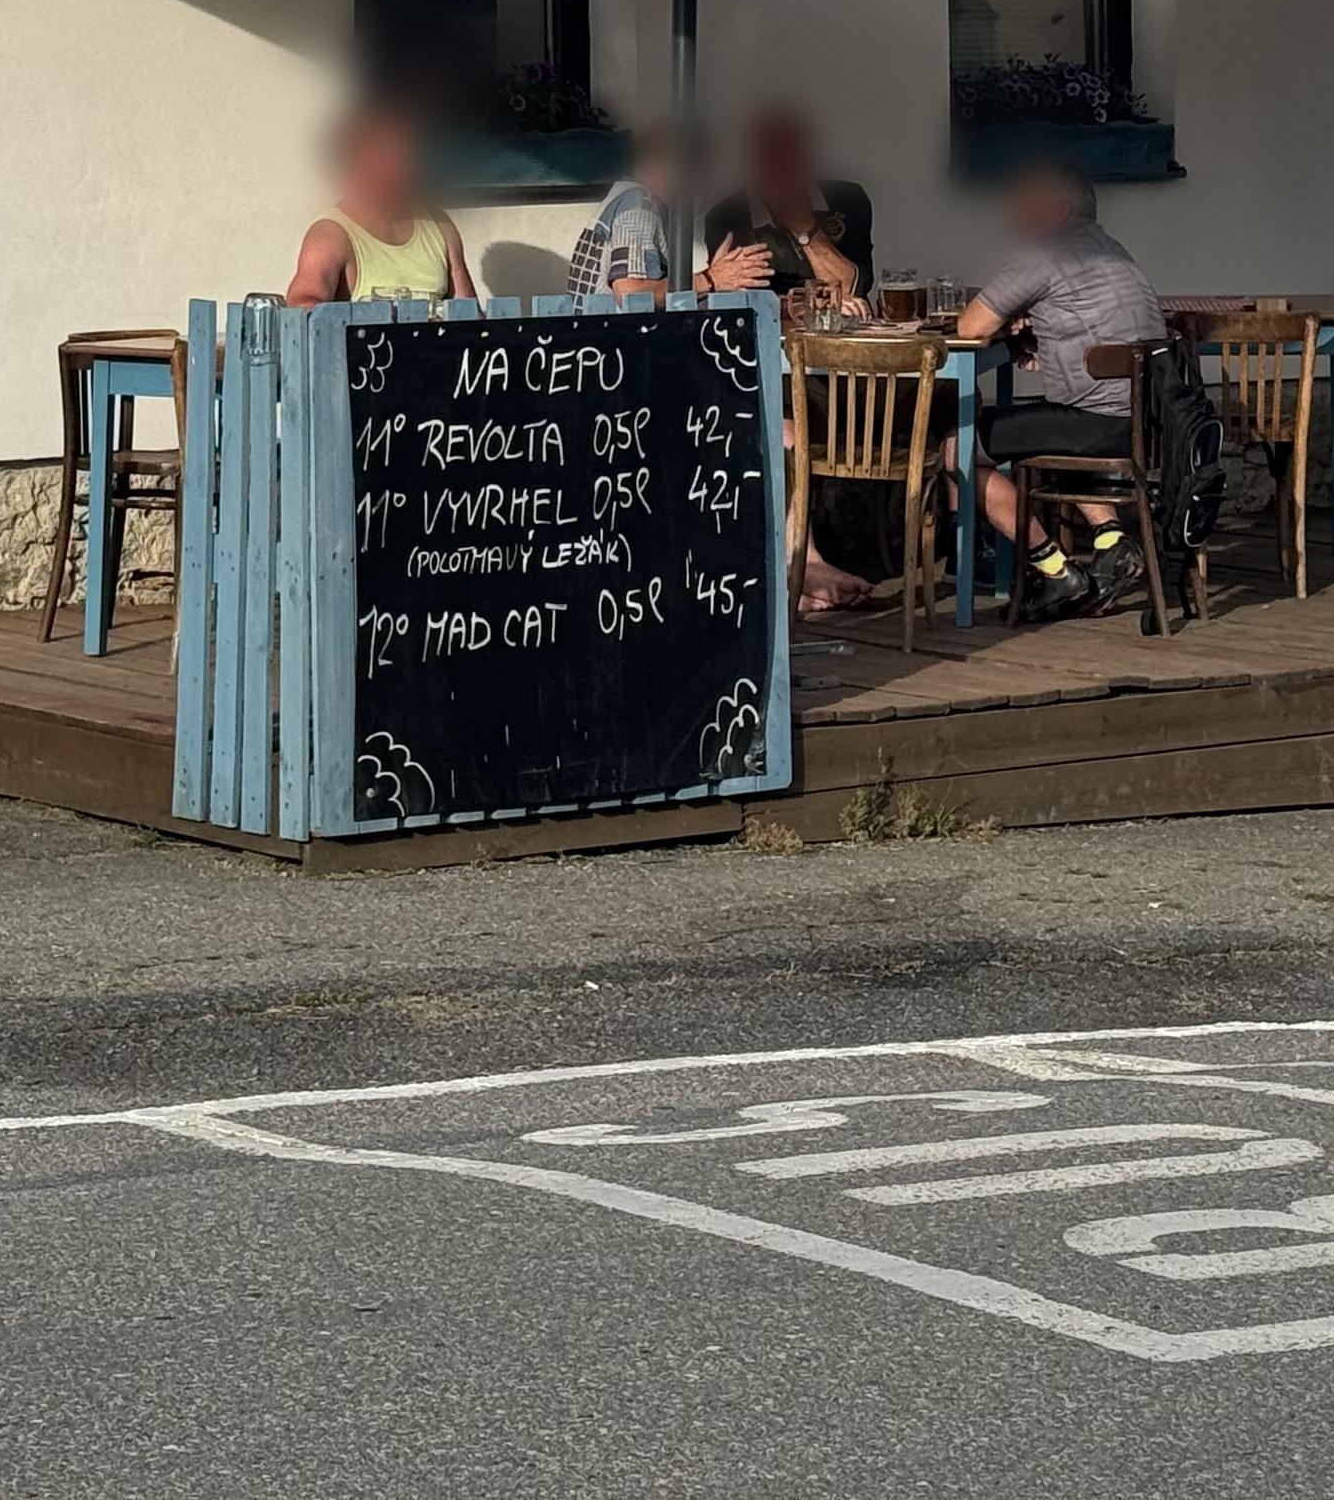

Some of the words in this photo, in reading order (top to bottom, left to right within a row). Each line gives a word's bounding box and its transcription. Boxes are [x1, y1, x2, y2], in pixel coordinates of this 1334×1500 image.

[453, 347, 510, 399] NA
[525, 334, 625, 396] ČEPU
[418, 417, 565, 470] REVOLTA
[423, 483, 578, 535] VYVRHEL
[421, 611, 492, 663] MAD
[503, 603, 567, 649] CAT
